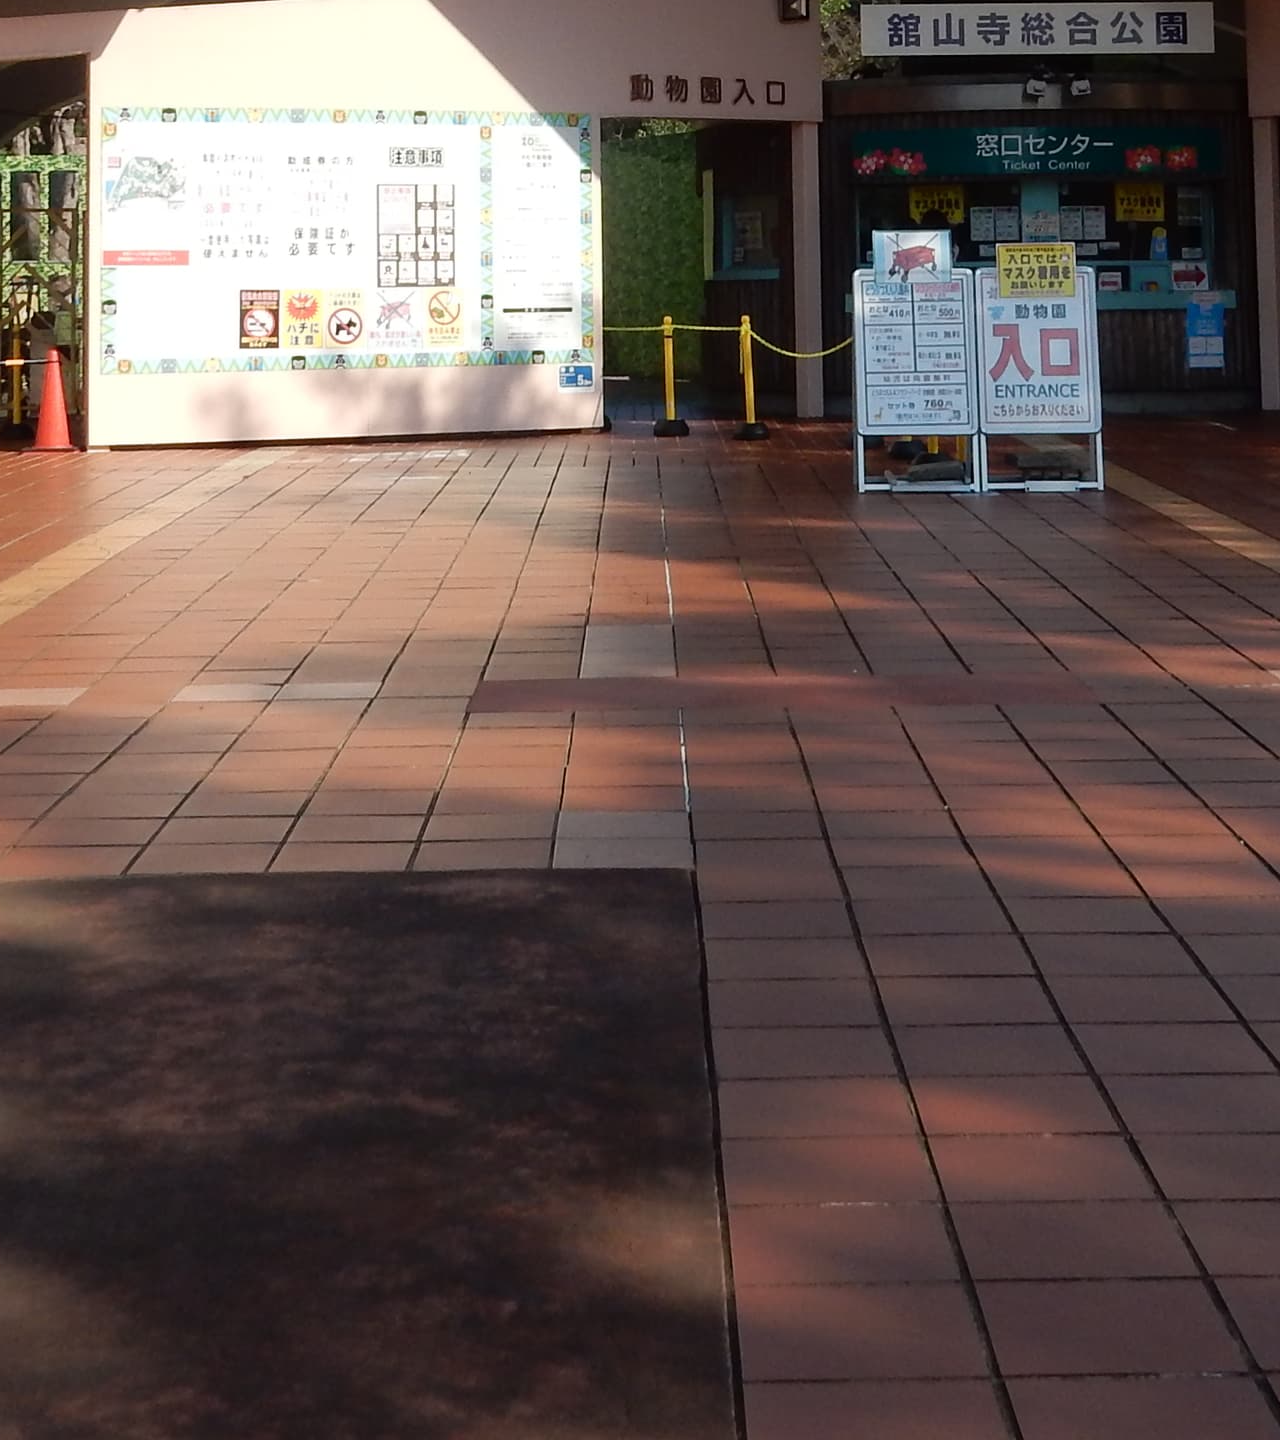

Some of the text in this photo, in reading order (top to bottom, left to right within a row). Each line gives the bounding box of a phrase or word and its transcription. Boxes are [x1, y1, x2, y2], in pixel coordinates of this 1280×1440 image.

[887, 11, 1189, 47] 舘山寺総合公園
[629, 73, 786, 106] 動物園入口
[976, 134, 1115, 157] 窓口センター
[1002, 159, 1091, 171] Ticket Center
[1008, 253, 1057, 265] 入口では
[1003, 266, 1072, 280] マスク着用を
[1015, 303, 1067, 319] 動物園
[989, 324, 1080, 382] 入口
[994, 383, 1080, 399] ENTRANCE
[993, 404, 1084, 417] こちらからお入りください
